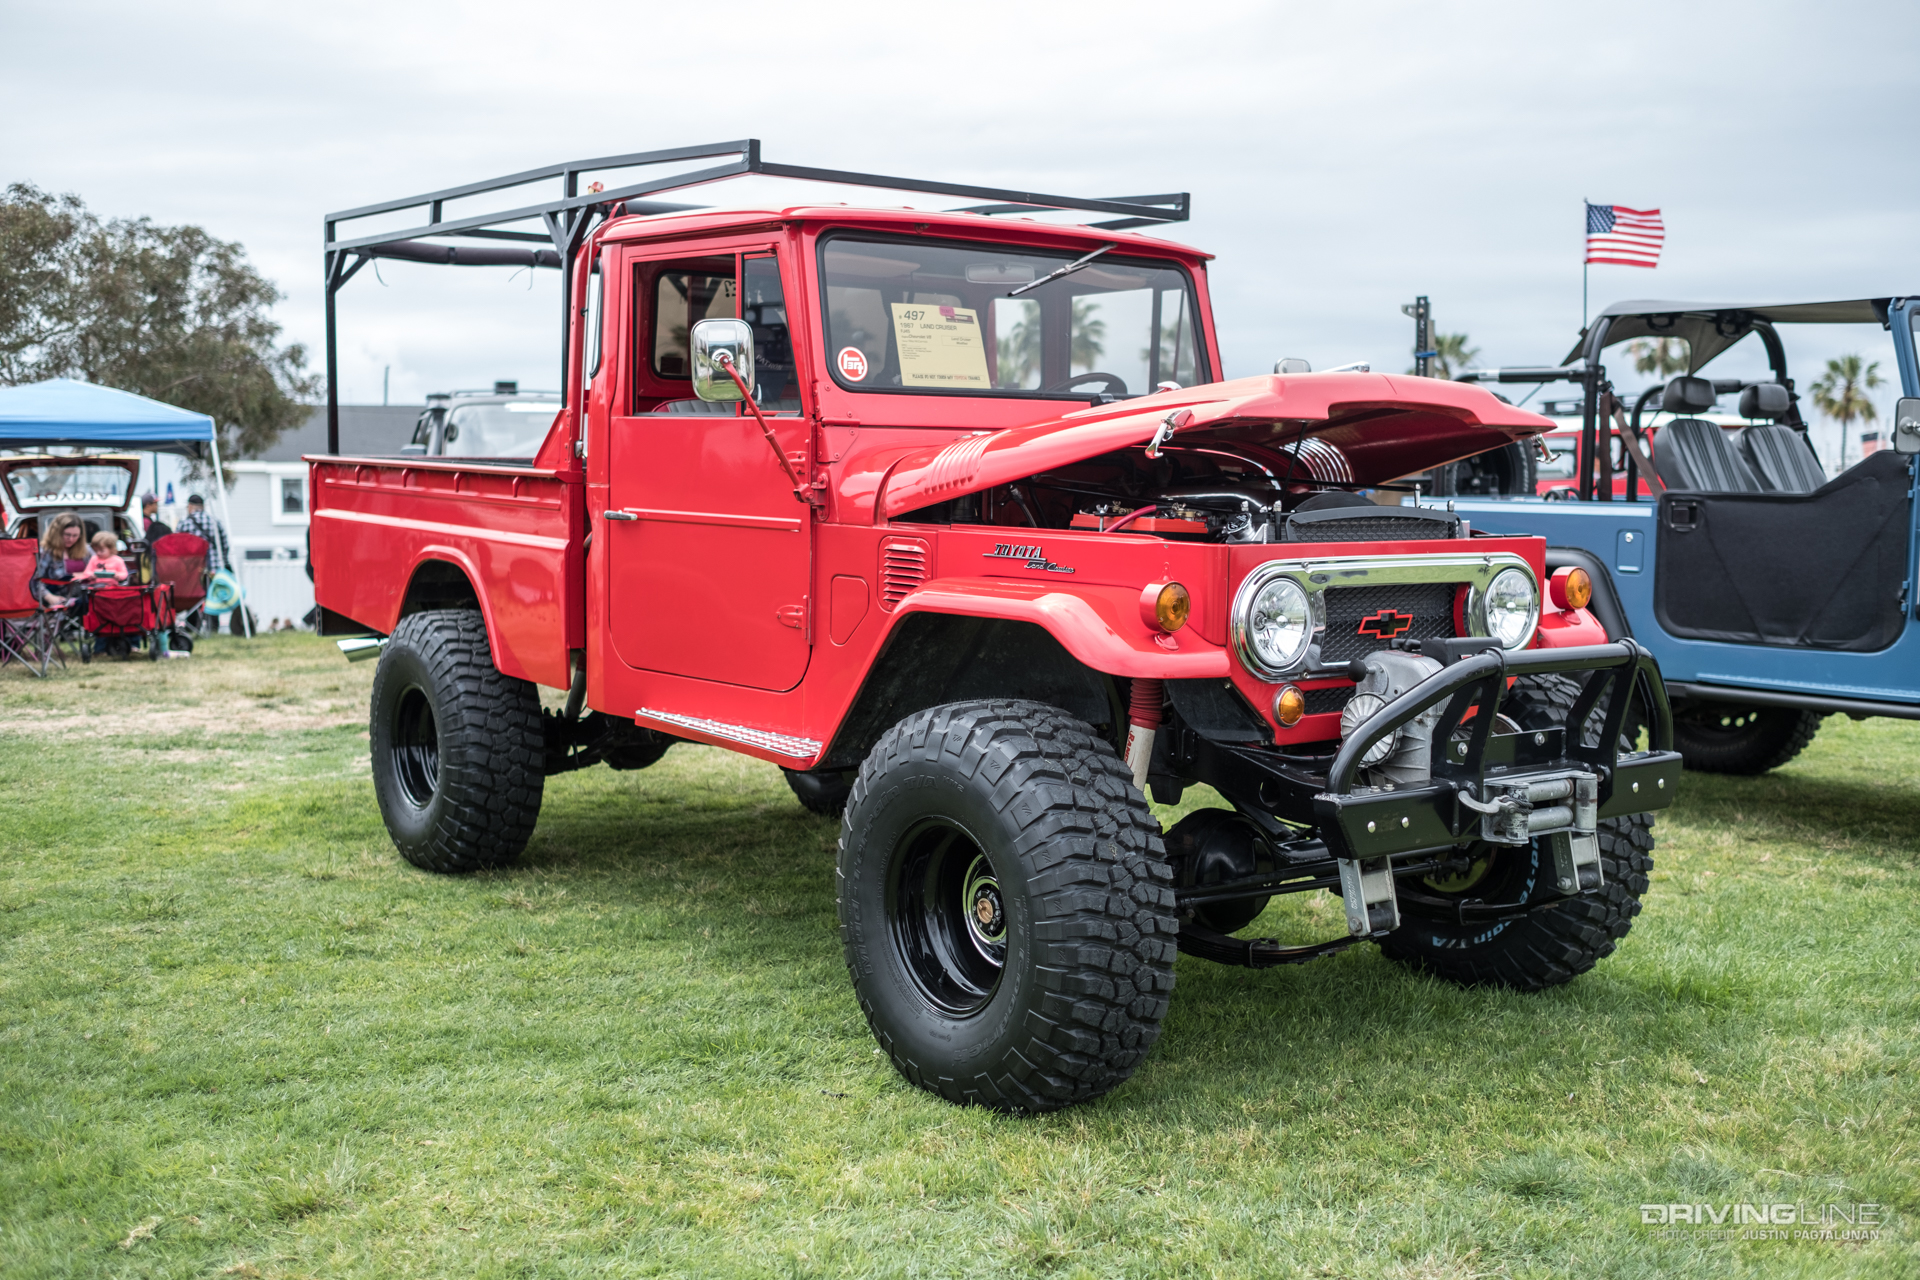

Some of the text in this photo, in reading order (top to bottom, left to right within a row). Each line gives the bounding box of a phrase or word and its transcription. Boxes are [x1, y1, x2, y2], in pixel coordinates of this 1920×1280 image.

[903, 310, 925, 321] 497
[993, 543, 1042, 558] TOYOTA
[1123, 730, 1136, 764] RANC
[851, 784, 900, 977] Mud-Terrain
[903, 774, 939, 791] T/A
[1474, 835, 1540, 945] ud-Teain
[1432, 934, 1468, 949] T/A
